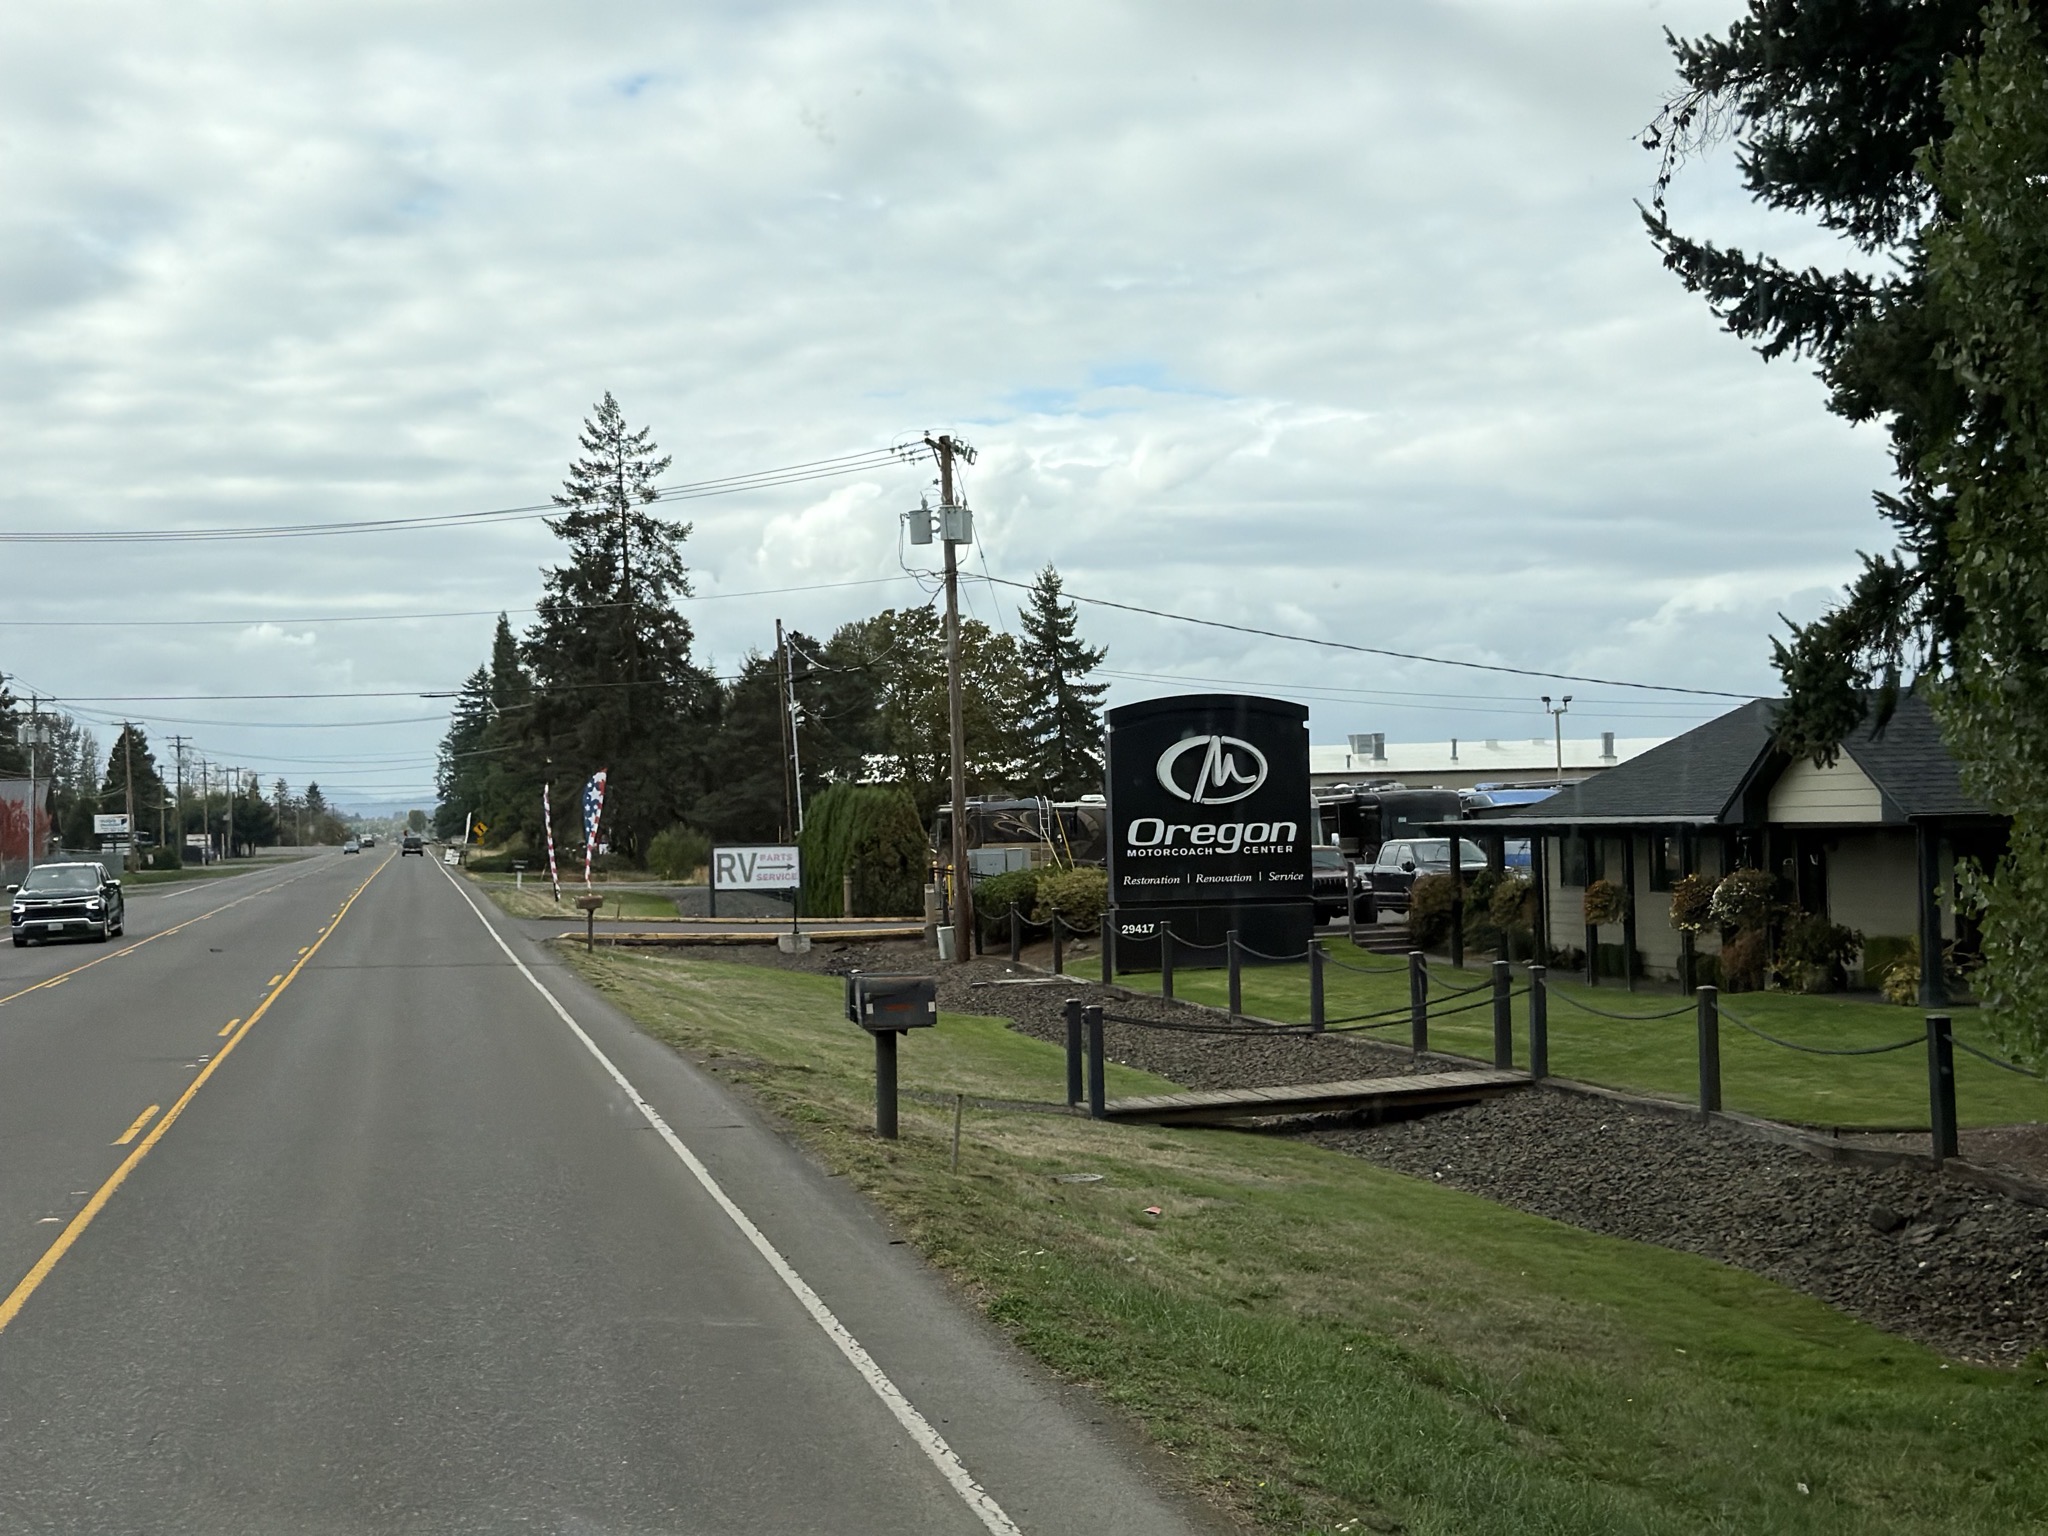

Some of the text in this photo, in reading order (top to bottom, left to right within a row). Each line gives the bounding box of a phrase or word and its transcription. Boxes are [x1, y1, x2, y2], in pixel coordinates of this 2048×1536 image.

[1127, 817, 1298, 854] Oregon
[759, 853, 793, 862] PARTS
[1126, 845, 1294, 858] MOTORCOACH CENTER
[716, 852, 758, 883] RV
[756, 872, 798, 881] SERVICE
[1123, 871, 1304, 886] Restoration Renovation Service
[1121, 923, 1155, 935] 29417
